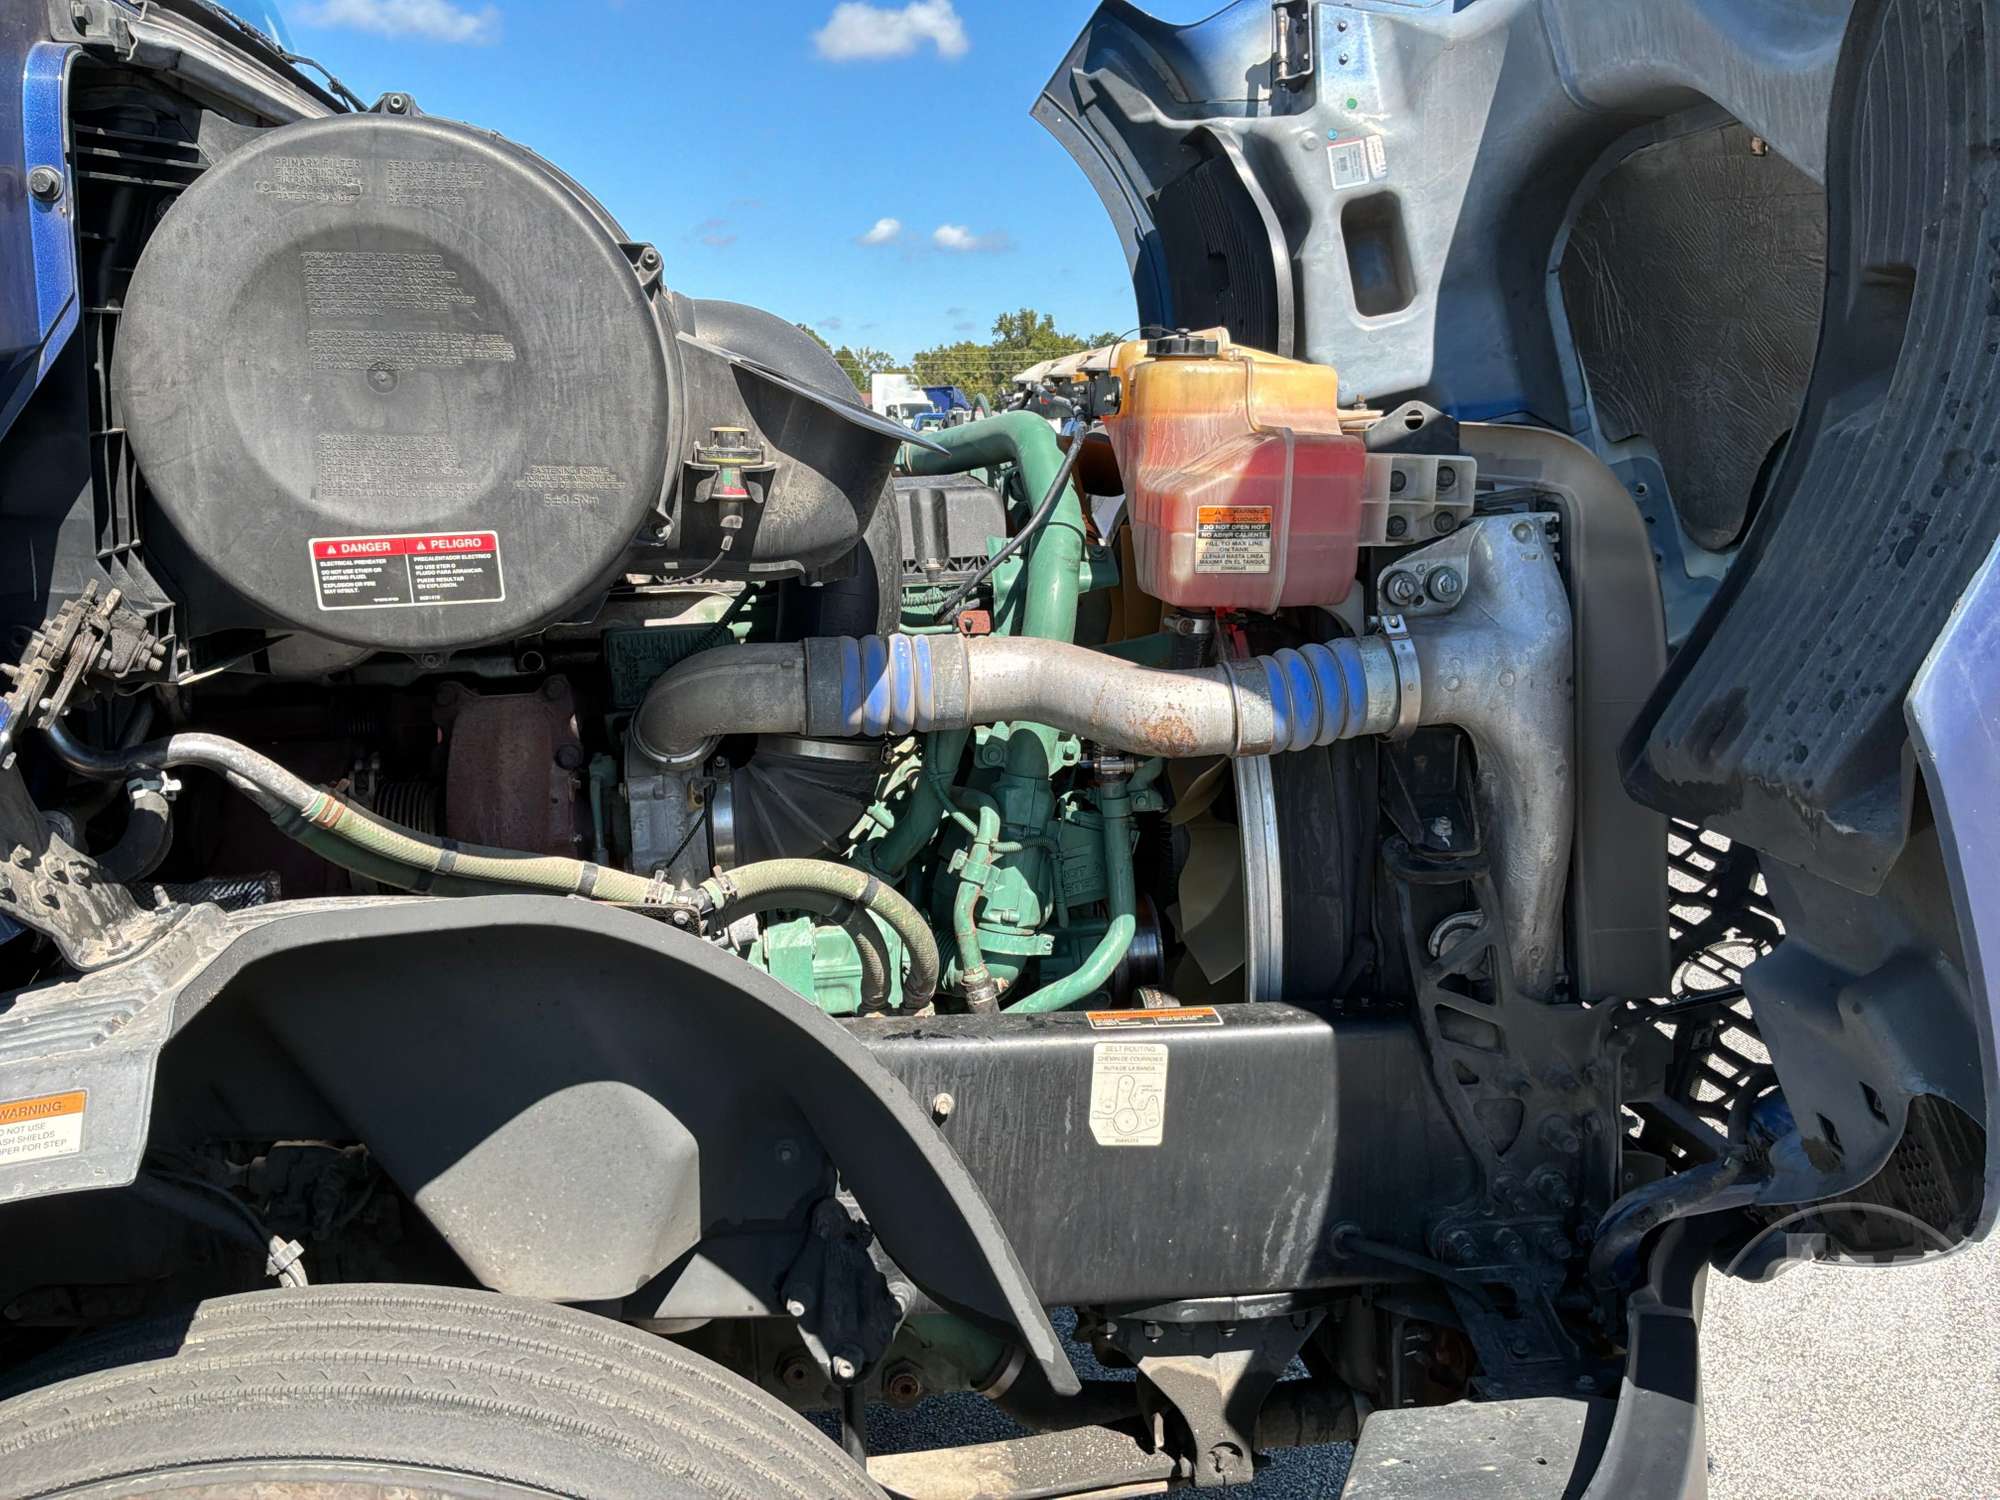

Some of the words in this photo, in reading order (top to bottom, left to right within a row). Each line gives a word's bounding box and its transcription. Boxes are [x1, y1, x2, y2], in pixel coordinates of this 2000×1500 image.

[274, 157, 321, 168] PRIMARY
[323, 158, 361, 168] FILTER
[341, 542, 391, 553] DANGER
[430, 538, 482, 549] PELIGRO
[0, 1101, 63, 1119] WARNING
[6, 1125, 25, 1135] NOT
[28, 1122, 46, 1132] USE
[17, 1130, 56, 1144] SHIELDS
[22, 1142, 41, 1152] FOR
[43, 1138, 67, 1150] STEP
